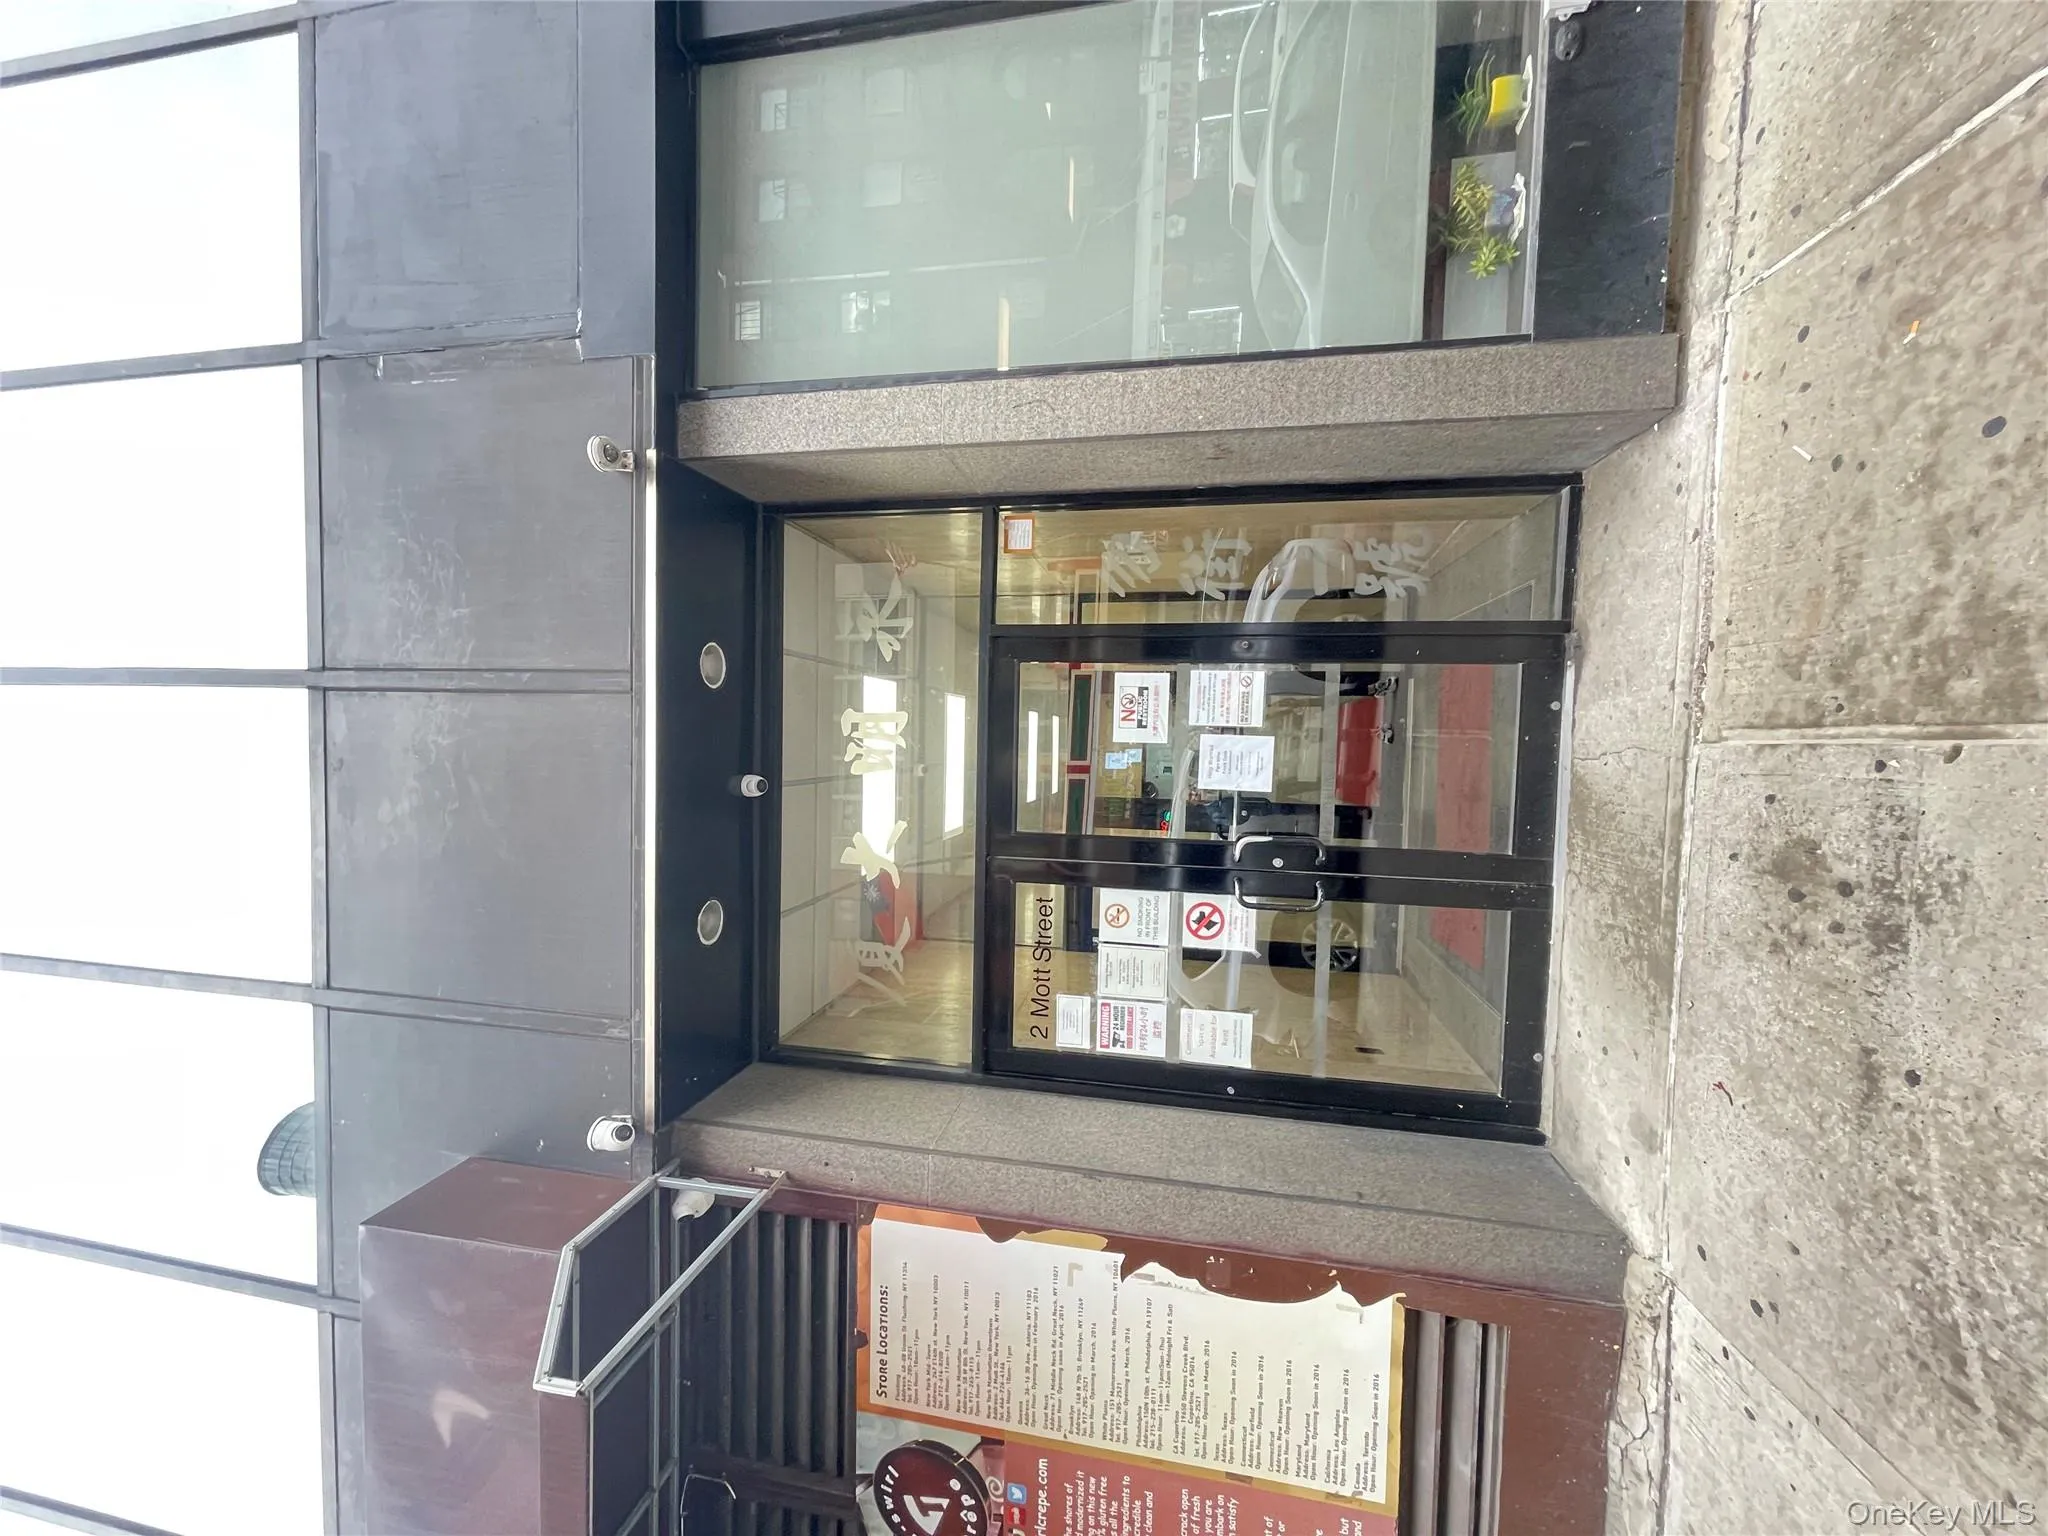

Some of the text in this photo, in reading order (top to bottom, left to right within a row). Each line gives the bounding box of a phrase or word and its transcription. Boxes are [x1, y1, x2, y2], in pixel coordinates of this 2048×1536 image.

[1146, 896, 1151, 906] OF
[1137, 928, 1143, 937] NO
[1030, 897, 1053, 1039] 2 Mott Street
[1101, 1004, 1110, 1046] WARNING
[1113, 1022, 1119, 1030] 24
[1053, 1287, 1058, 1296] NY
[1078, 1320, 1083, 1328] NY
[876, 1286, 888, 1398] Store Locations:
[1064, 1482, 1073, 1494] of
[1122, 1475, 1130, 1485] to
[881, 1465, 917, 1536] -swirl
[950, 1478, 977, 1536] rêpe
[1075, 1470, 1084, 1530] modernized it
[1086, 1495, 1096, 1513] this
[1098, 1476, 1108, 1527] gluten free
[1182, 1488, 1190, 1510] open
[1218, 1494, 1224, 1506] on
[1064, 1495, 1073, 1525] shores
[1109, 1500, 1118, 1529] all the
[1143, 1490, 1153, 1533] clean and
[1190, 1496, 1200, 1534] of fresh
[1227, 1497, 1240, 1531] satisfy
[1088, 1516, 1095, 1526] on
[1205, 1516, 1214, 1533] you
[1264, 1516, 1274, 1528] of
[1278, 1520, 1285, 1532] or
[1339, 1518, 1349, 1535] but
